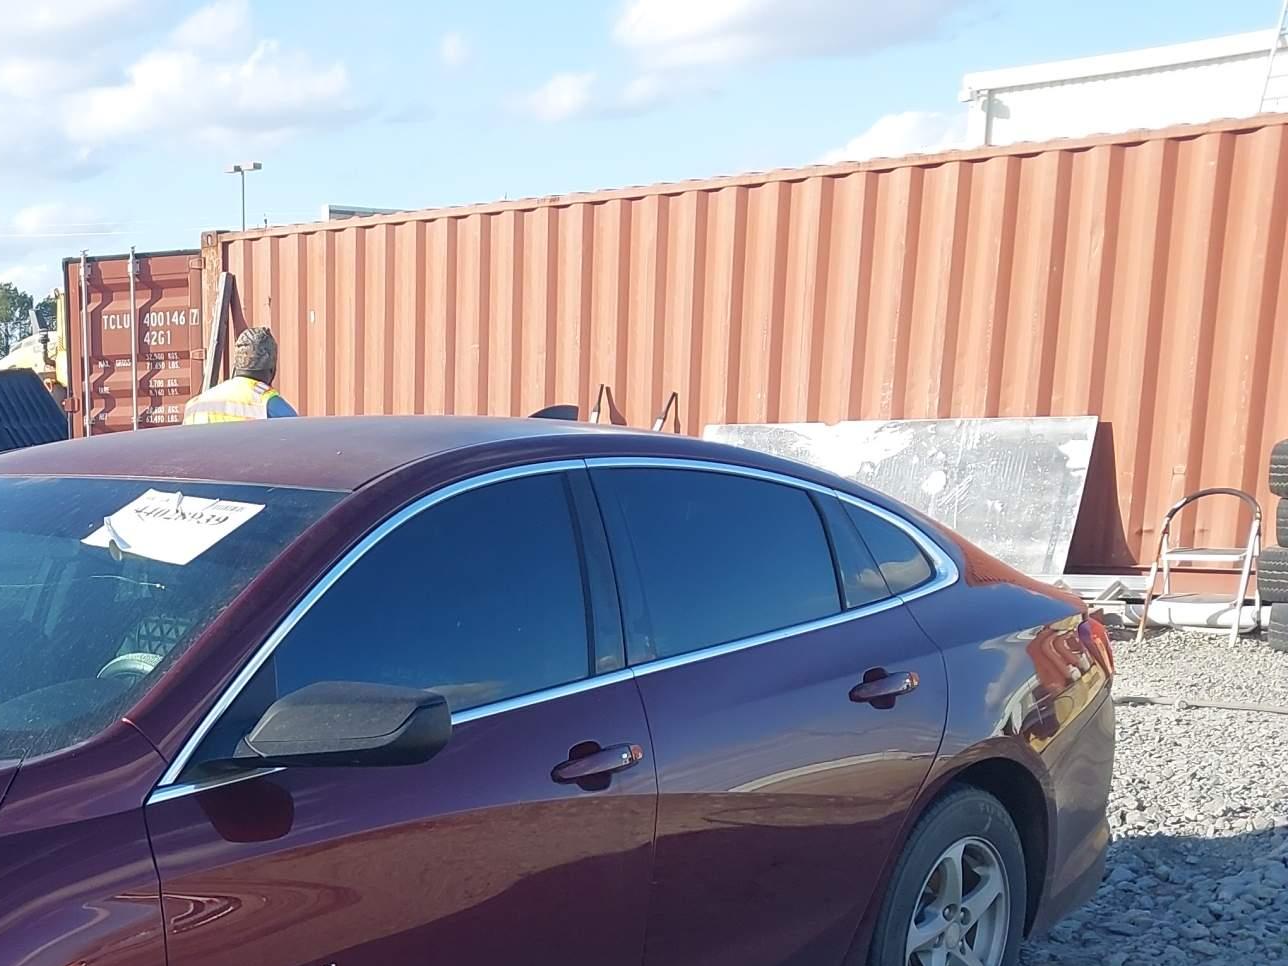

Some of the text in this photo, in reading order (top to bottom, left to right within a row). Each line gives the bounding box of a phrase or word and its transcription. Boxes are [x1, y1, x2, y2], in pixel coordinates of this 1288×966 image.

[103, 314, 130, 329] TCLU
[144, 311, 185, 326] 400146
[144, 331, 170, 345] 42G1
